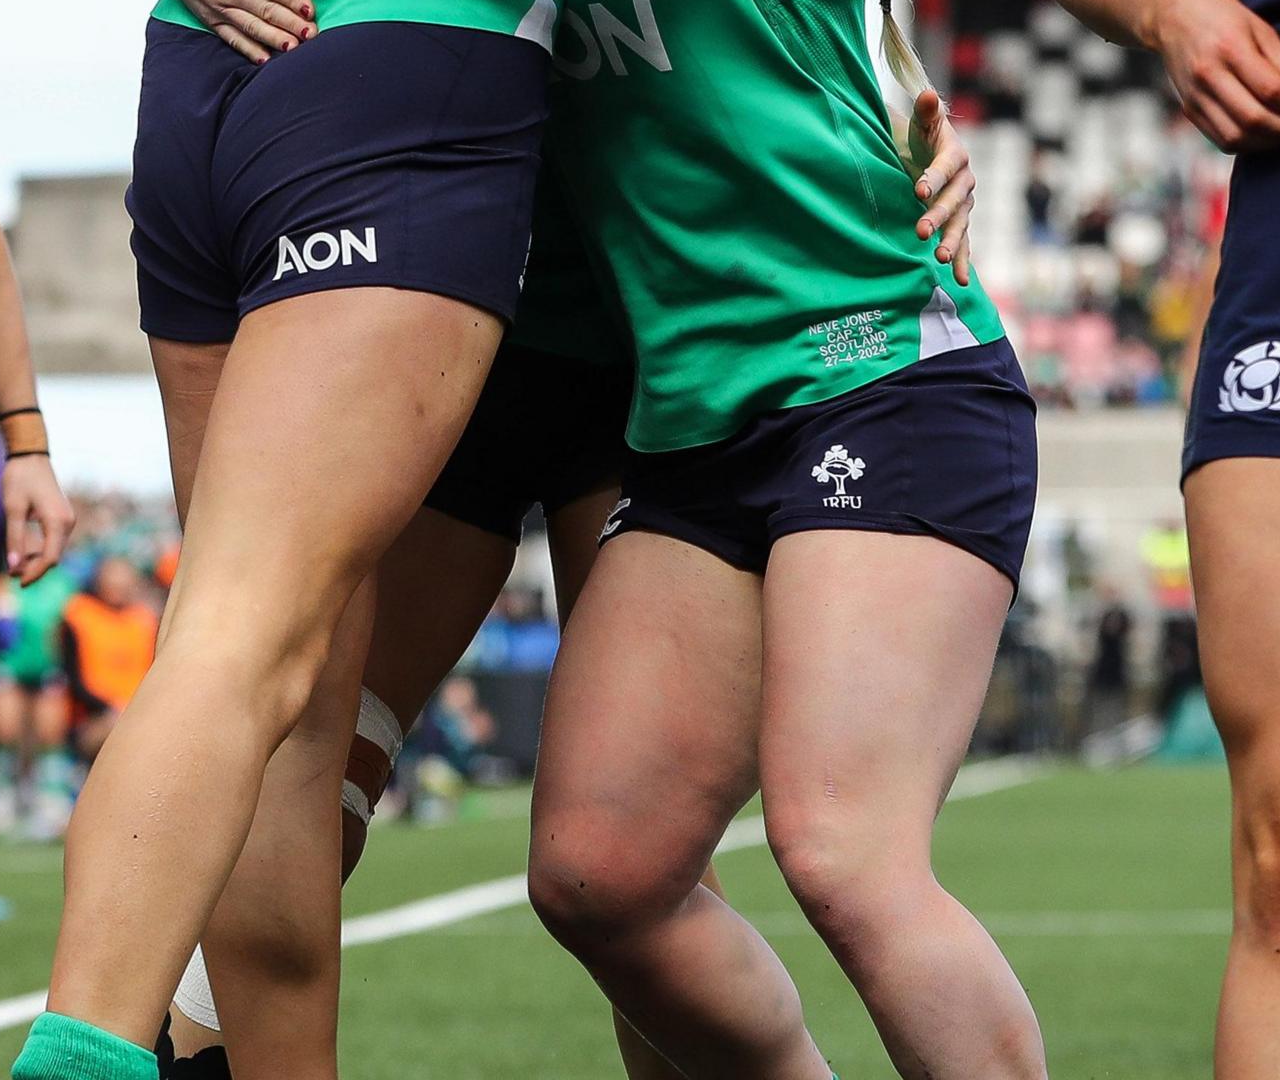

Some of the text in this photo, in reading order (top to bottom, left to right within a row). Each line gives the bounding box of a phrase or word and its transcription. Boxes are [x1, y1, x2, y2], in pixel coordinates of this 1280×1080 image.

[272, 227, 377, 281] AON
[808, 309, 882, 336] NEVE JONES
[826, 323, 874, 343] CAP 26
[819, 330, 888, 356] SCOTLAND
[824, 342, 888, 368] 27-4-2024
[822, 496, 862, 509] IRFU
